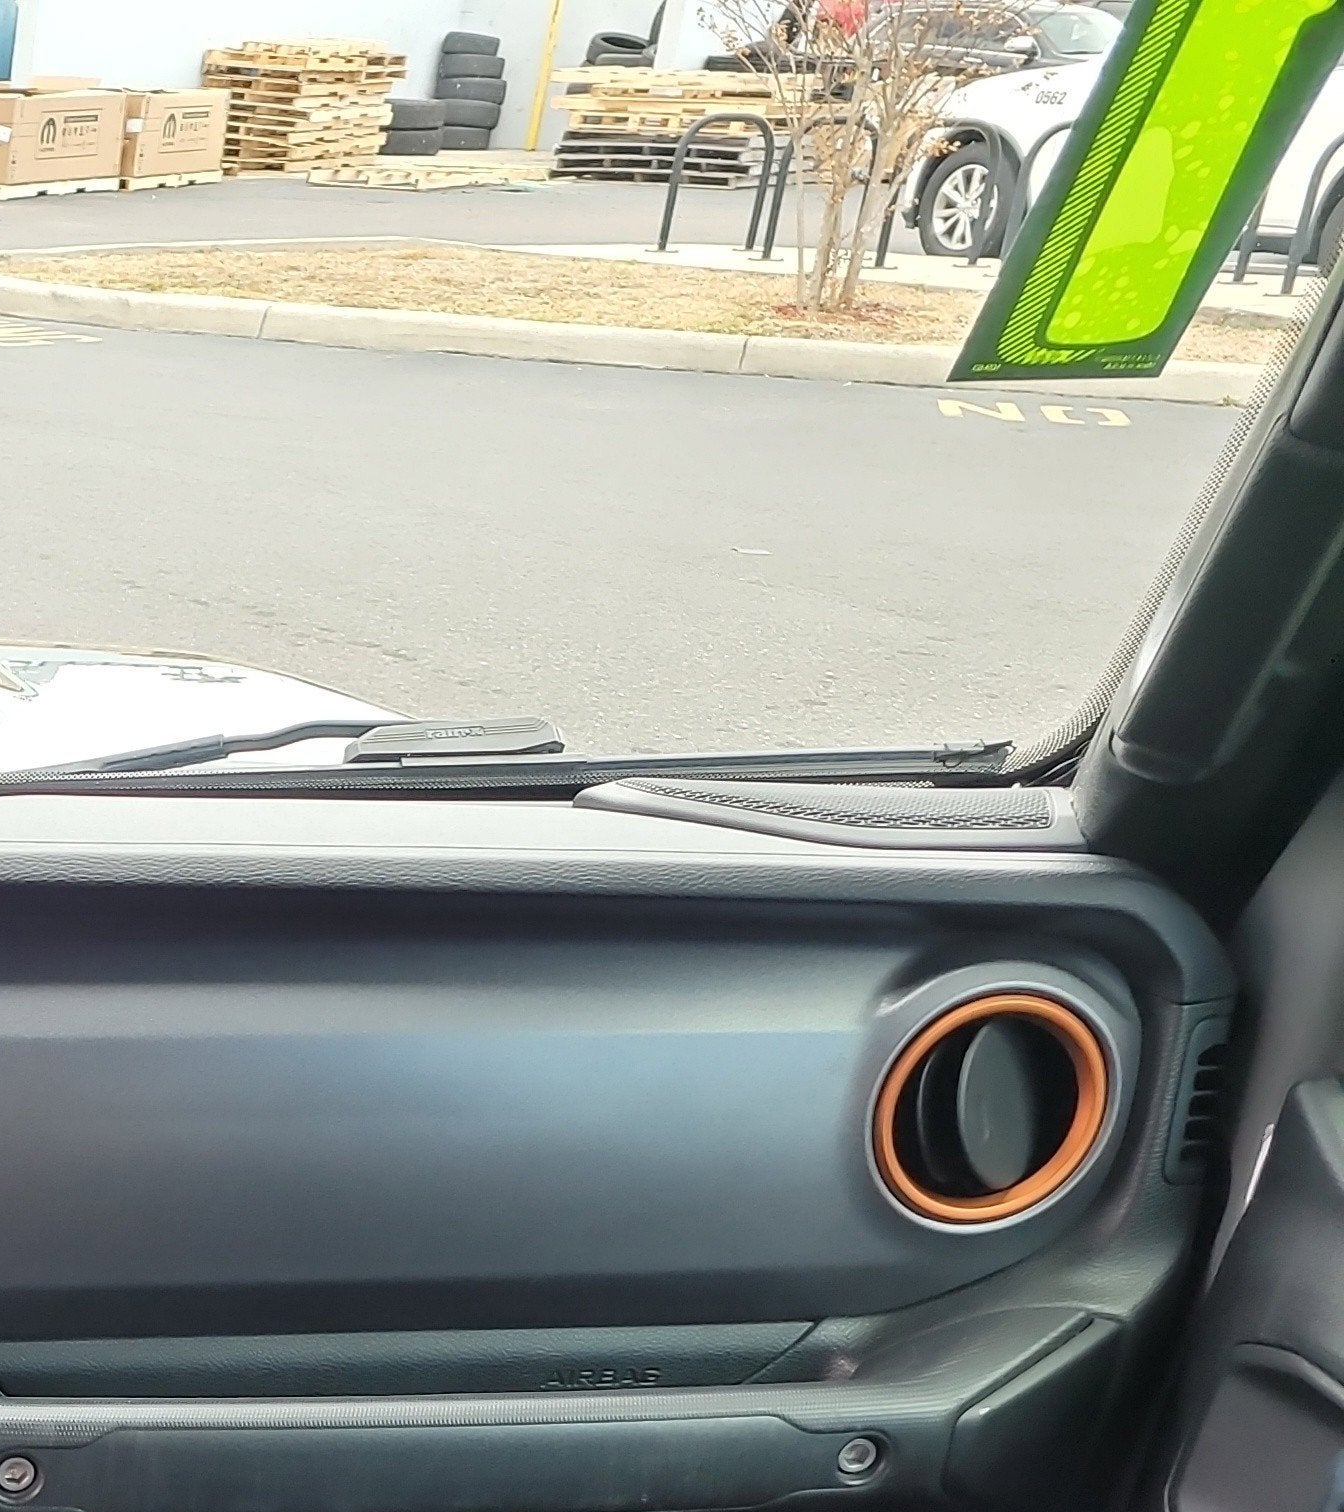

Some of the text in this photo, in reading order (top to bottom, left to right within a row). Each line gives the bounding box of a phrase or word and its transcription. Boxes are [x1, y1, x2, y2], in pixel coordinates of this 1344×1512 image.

[1035, 90, 1068, 105] 0562
[936, 398, 1133, 427] NO
[539, 1369, 660, 1388] AIRBAG
